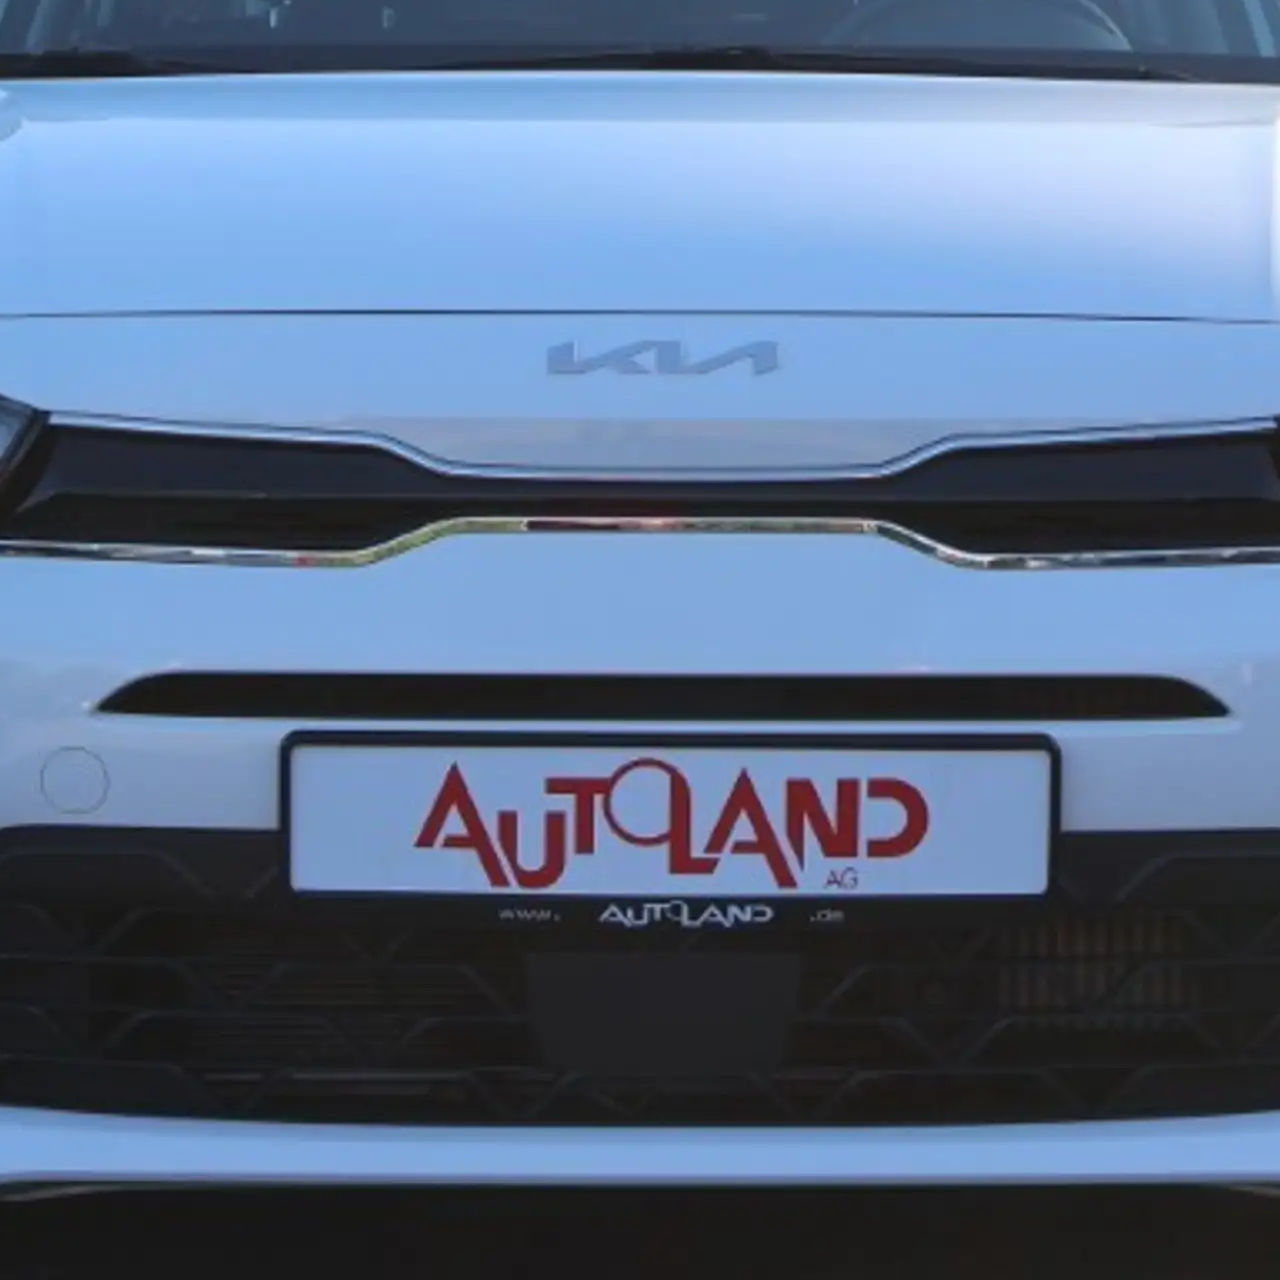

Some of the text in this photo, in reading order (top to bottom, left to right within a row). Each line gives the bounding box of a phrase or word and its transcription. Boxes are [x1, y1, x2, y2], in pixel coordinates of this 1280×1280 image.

[413, 756, 930, 890] AUTOLAND
[823, 866, 859, 890] AG
[599, 900, 774, 928] AUTOLAND
